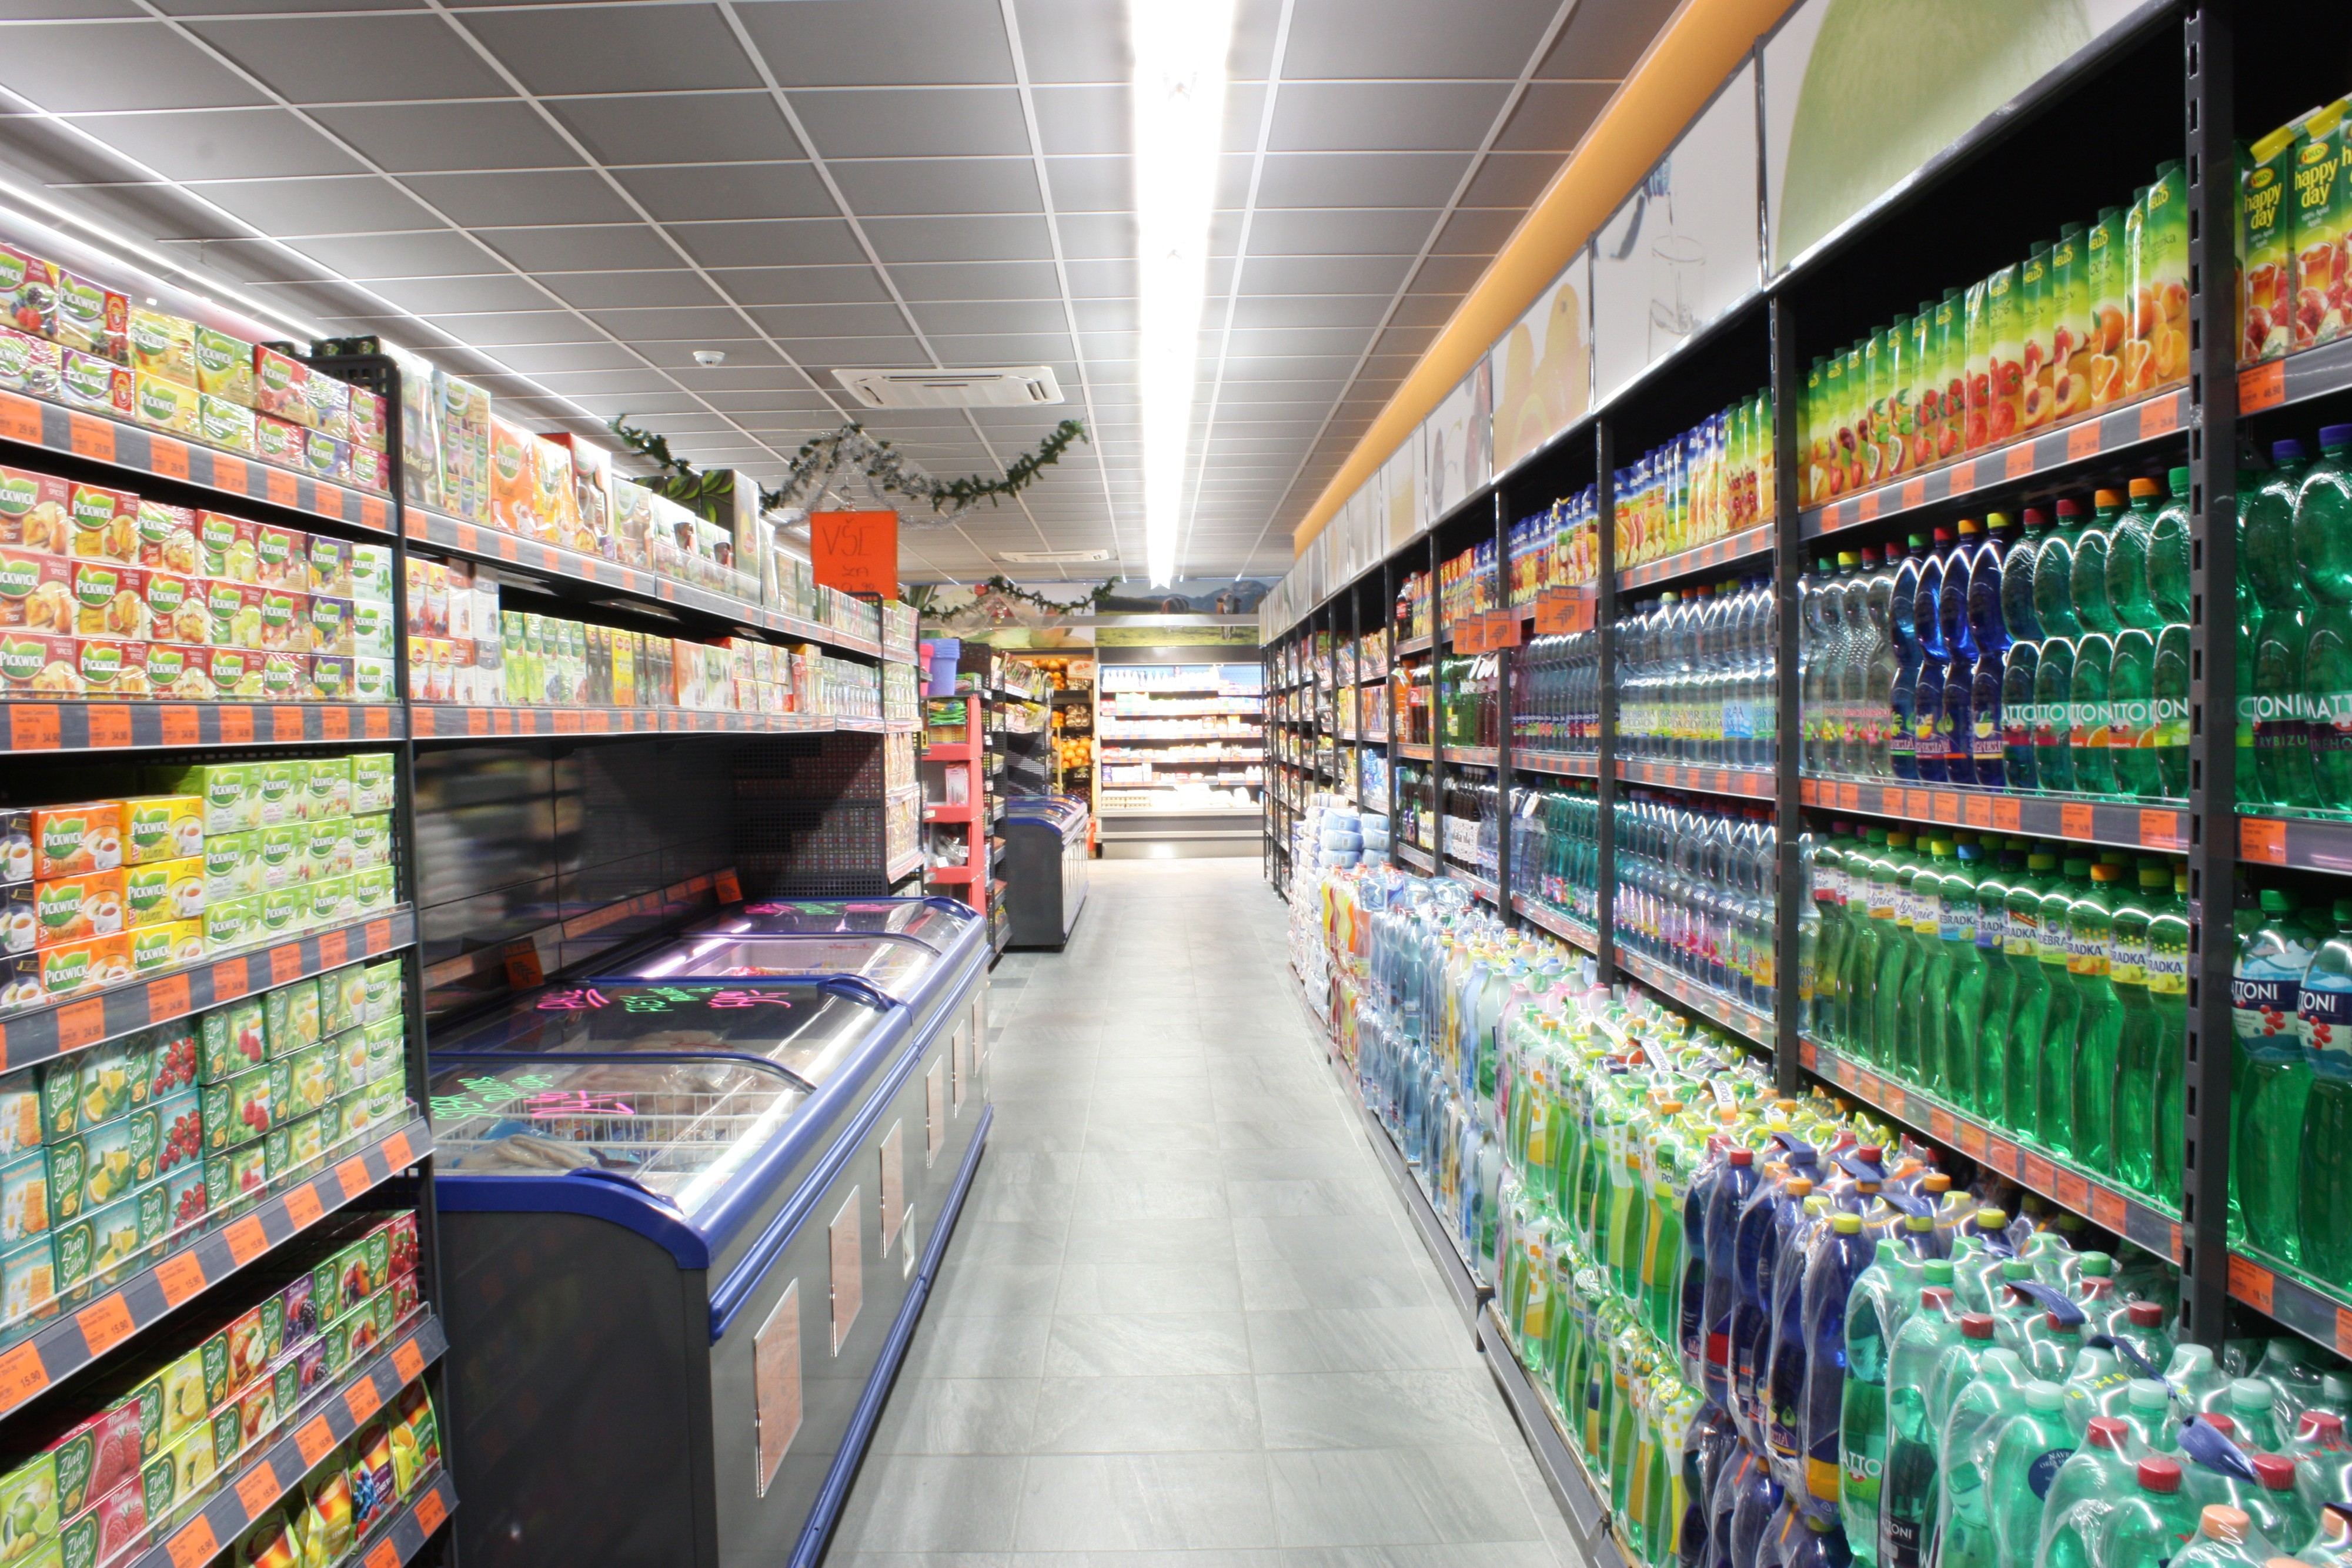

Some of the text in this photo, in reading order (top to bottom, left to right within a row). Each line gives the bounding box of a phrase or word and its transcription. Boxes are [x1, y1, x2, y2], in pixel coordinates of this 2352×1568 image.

[2295, 158, 2339, 192] happy
[2244, 182, 2283, 213] happy
[2301, 182, 2331, 208] day
[2250, 206, 2276, 230] day
[60, 287, 102, 315] PICKWICK
[196, 343, 232, 365] PICKWICK
[262, 364, 290, 384] PICKWICK
[141, 390, 177, 413] PICKWICK
[308, 444, 334, 462] PICKWICK
[72, 500, 113, 520] PICKWICK
[203, 527, 234, 544] PICKWICK
[821, 517, 874, 557] VŠE
[259, 540, 289, 556] PICKWICK
[312, 550, 338, 564] PICKWICK
[77, 579, 115, 596] PICKWICK
[149, 587, 182, 603] PICKWICK
[209, 596, 240, 611] PICKWICK
[262, 604, 292, 618] PICKWICK
[0, 651, 45, 668] PICKWICK
[82, 657, 121, 672] PICKWICK
[147, 660, 182, 674] PICKWICK
[212, 663, 243, 677] PICKWICK
[210, 783, 242, 795] PICKWICK
[263, 778, 290, 791] PICKWICK
[311, 775, 336, 787] PICKWICK
[132, 821, 170, 835] PICKWICK
[44, 830, 84, 848] PICKWICK
[310, 836, 336, 849] PICKWICK
[208, 851, 239, 864] PICKWICK
[265, 844, 292, 856] PICKWICK
[128, 884, 169, 901] PICKWICK
[38, 897, 82, 915] PICKWICK
[315, 896, 340, 909] PICKWICK
[266, 906, 293, 920] PICKWICK
[210, 919, 241, 934] PICKWICK
[135, 945, 172, 964] PICKWICK
[45, 964, 89, 986] PICKWICK
[54, 1148, 79, 1178] Zlatý
[62, 1233, 86, 1262] Zlatý
[111, 1319, 129, 1336] 15.90
[20, 1369, 42, 1388] 15.90
[59, 1443, 86, 1478] Zlatý
[148, 1467, 169, 1492] Zlatý
[197, 1538, 214, 1557] 15.90
